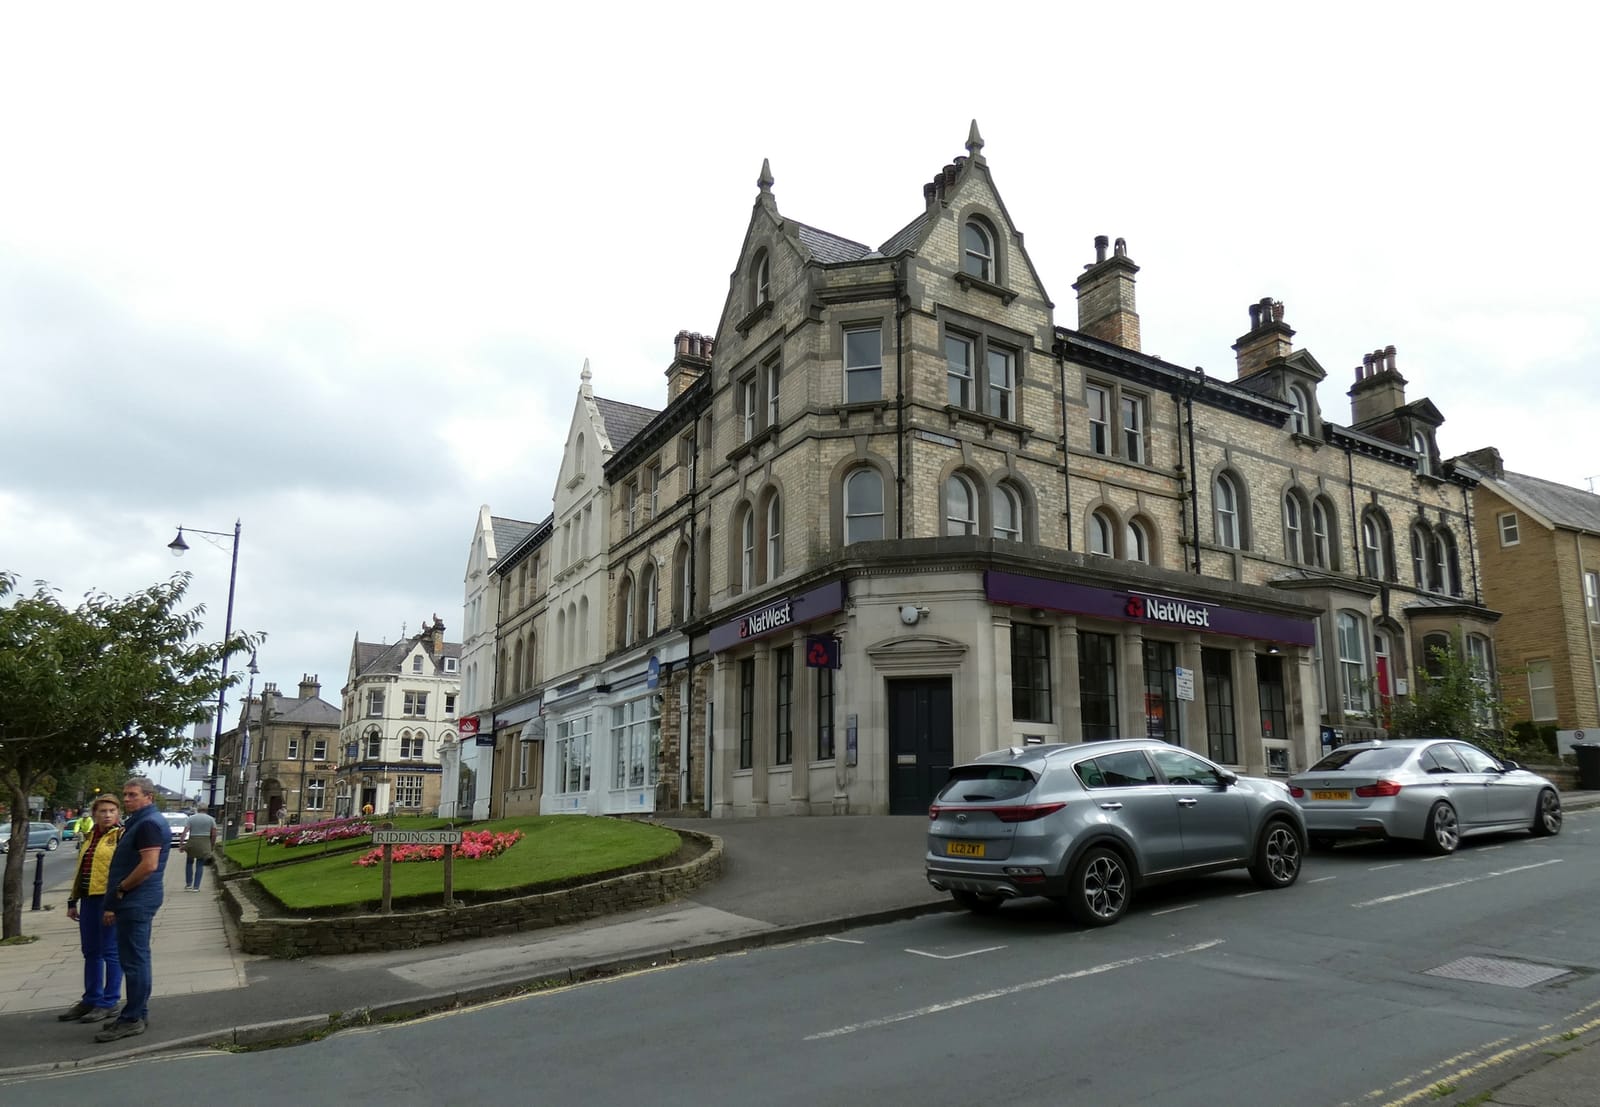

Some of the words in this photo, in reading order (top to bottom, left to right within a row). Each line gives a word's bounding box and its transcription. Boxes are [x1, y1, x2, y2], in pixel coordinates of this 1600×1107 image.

[749, 603, 790, 635] NatWest
[1146, 598, 1210, 627] NatWest
[376, 832, 436, 843] RIDDINGS
[440, 832, 458, 843] RD
